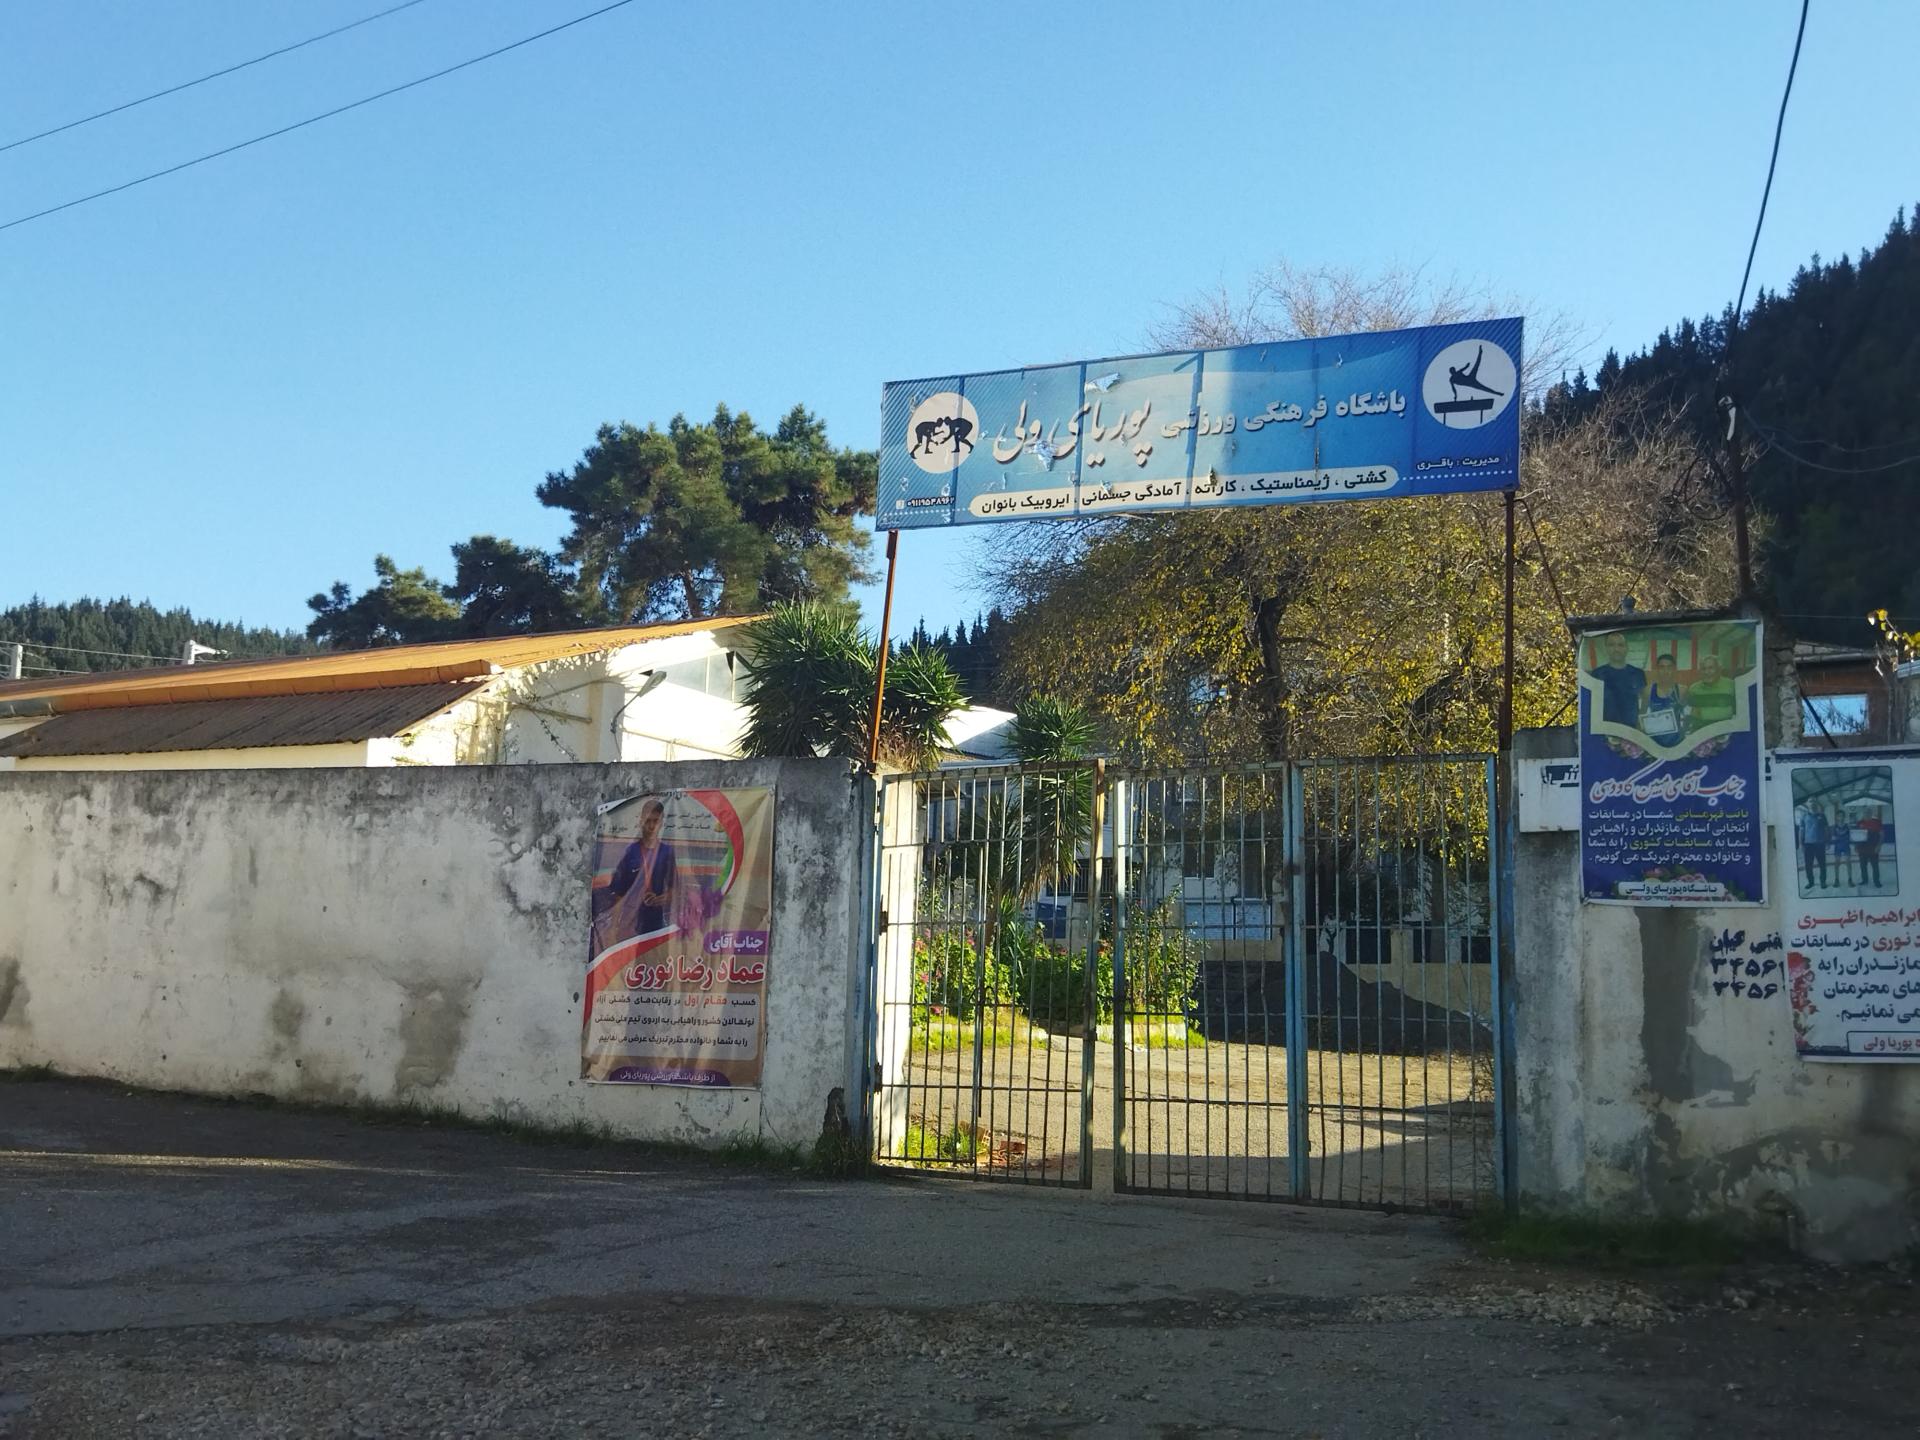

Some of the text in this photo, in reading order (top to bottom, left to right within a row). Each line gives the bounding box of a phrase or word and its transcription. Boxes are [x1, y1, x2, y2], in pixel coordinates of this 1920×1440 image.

[1336, 389, 1406, 417] باشگاه
[1243, 395, 1327, 431] فرهنگی
[1417, 458, 1454, 471] باقری
[1462, 456, 1500, 468] مدیریت
[1250, 473, 1331, 494] ژیمناستیک
[1344, 469, 1388, 489] کشتی
[1135, 482, 1181, 502] آمادگی
[1195, 478, 1237, 497] کاراته
[982, 498, 1017, 513] بانوان
[1021, 494, 1070, 511] ایروبیک
[1082, 489, 1132, 507] جسمانی
[1697, 775, 1747, 805] جناب
[1588, 809, 1630, 821] مسابقات
[1630, 810, 1642, 822] در
[1643, 808, 1674, 819] شما
[1675, 808, 1724, 822] قهرمانی
[1630, 826, 1636, 836] و
[1638, 822, 1681, 836] مازندران
[1682, 822, 1710, 836] استان
[1712, 822, 1750, 836] انتخابی
[1588, 837, 1750, 850] شما به مسابقات کشوری را به شما
[1622, 854, 1640, 865] می
[1641, 850, 1670, 865] تبریک
[1671, 852, 1703, 865] محترم
[1704, 851, 1743, 865] خانواده
[1744, 854, 1751, 865] و
[1798, 908, 1864, 929] اظهری
[710, 933, 764, 952] جناب آقای
[1791, 934, 1851, 951] مسابقات
[1853, 935, 1870, 951] در
[1873, 932, 1912, 951] نوری
[625, 955, 766, 990] عماد رضا نوری
[1818, 958, 1832, 974] به
[1833, 956, 1844, 975] را
[1824, 981, 1890, 999] محترمتان
[684, 995, 699, 1007] اول
[704, 995, 727, 1008] مقام
[732, 998, 756, 1008] کسب
[628, 1014, 641, 1025] تیم
[1864, 1036, 1886, 1052] ولی
